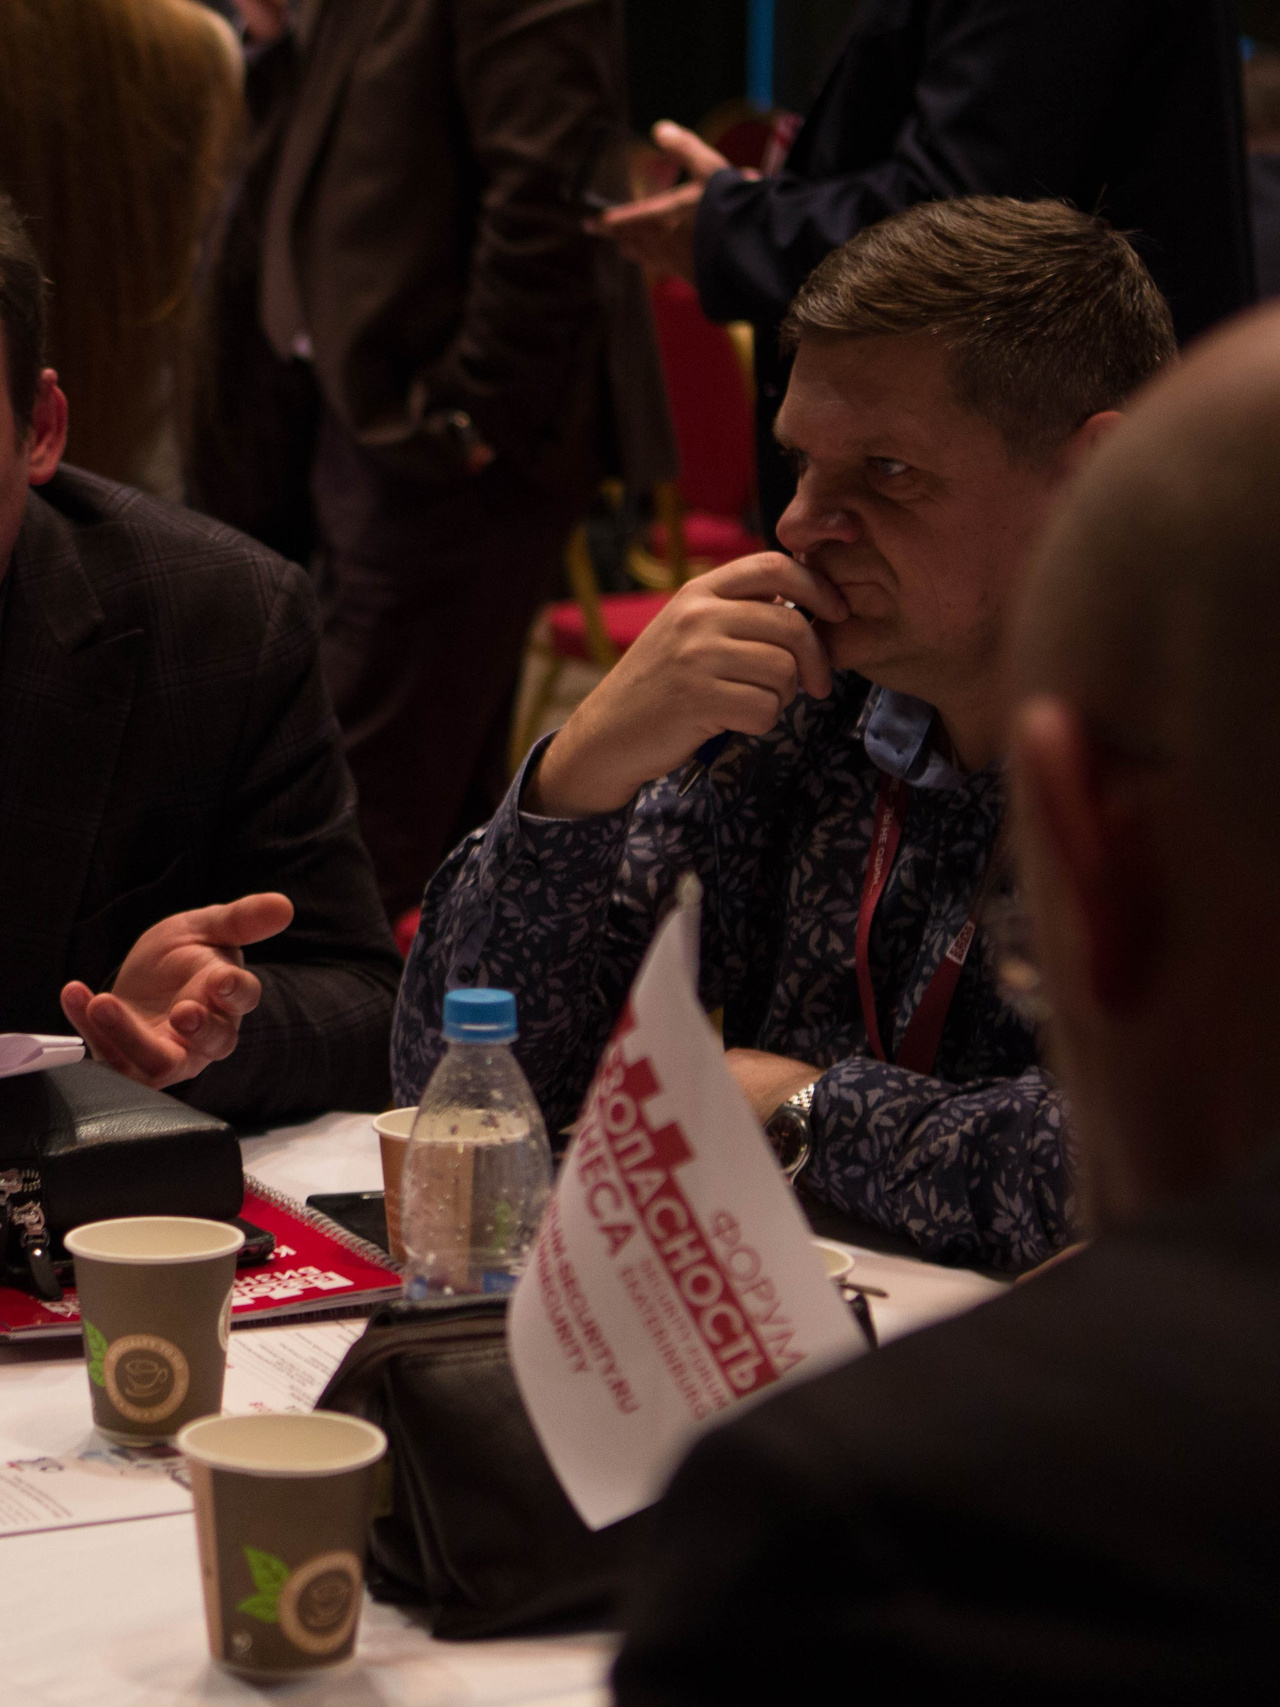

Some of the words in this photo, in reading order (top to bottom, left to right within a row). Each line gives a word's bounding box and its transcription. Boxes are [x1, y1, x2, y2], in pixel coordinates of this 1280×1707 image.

[577, 1122, 636, 1258] НЕСА
[596, 1052, 767, 1391] ЗОПАСНОСТЬ
[711, 1210, 807, 1373] ФОРУМ
